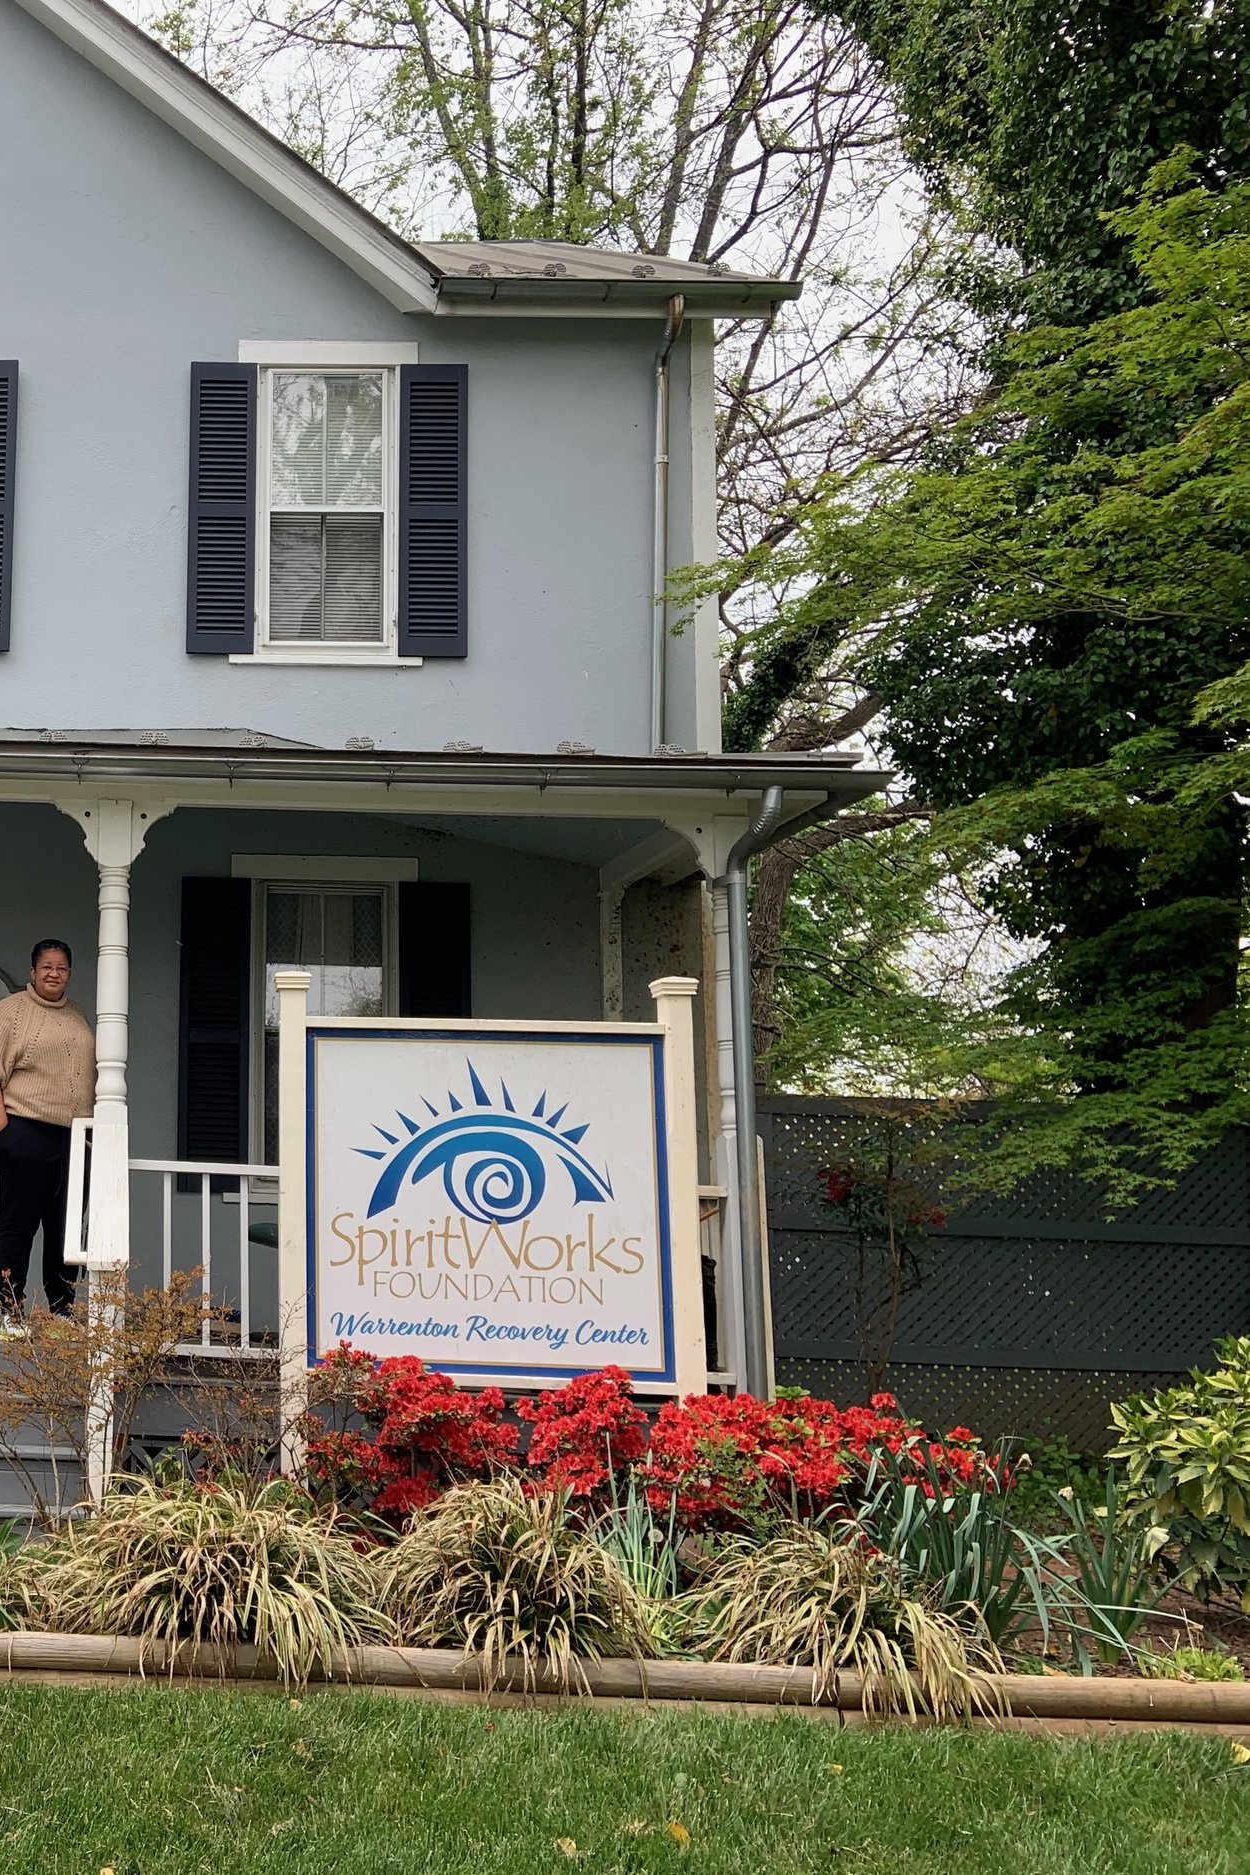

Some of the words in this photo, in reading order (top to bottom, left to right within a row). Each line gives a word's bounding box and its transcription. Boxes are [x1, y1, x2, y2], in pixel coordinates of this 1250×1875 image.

[329, 1211, 645, 1286] SpiritWorks
[373, 1269, 604, 1306] FOUNDATION
[329, 1311, 460, 1339] Warrenton
[465, 1315, 570, 1350] Recovery
[575, 1319, 650, 1346] Center
